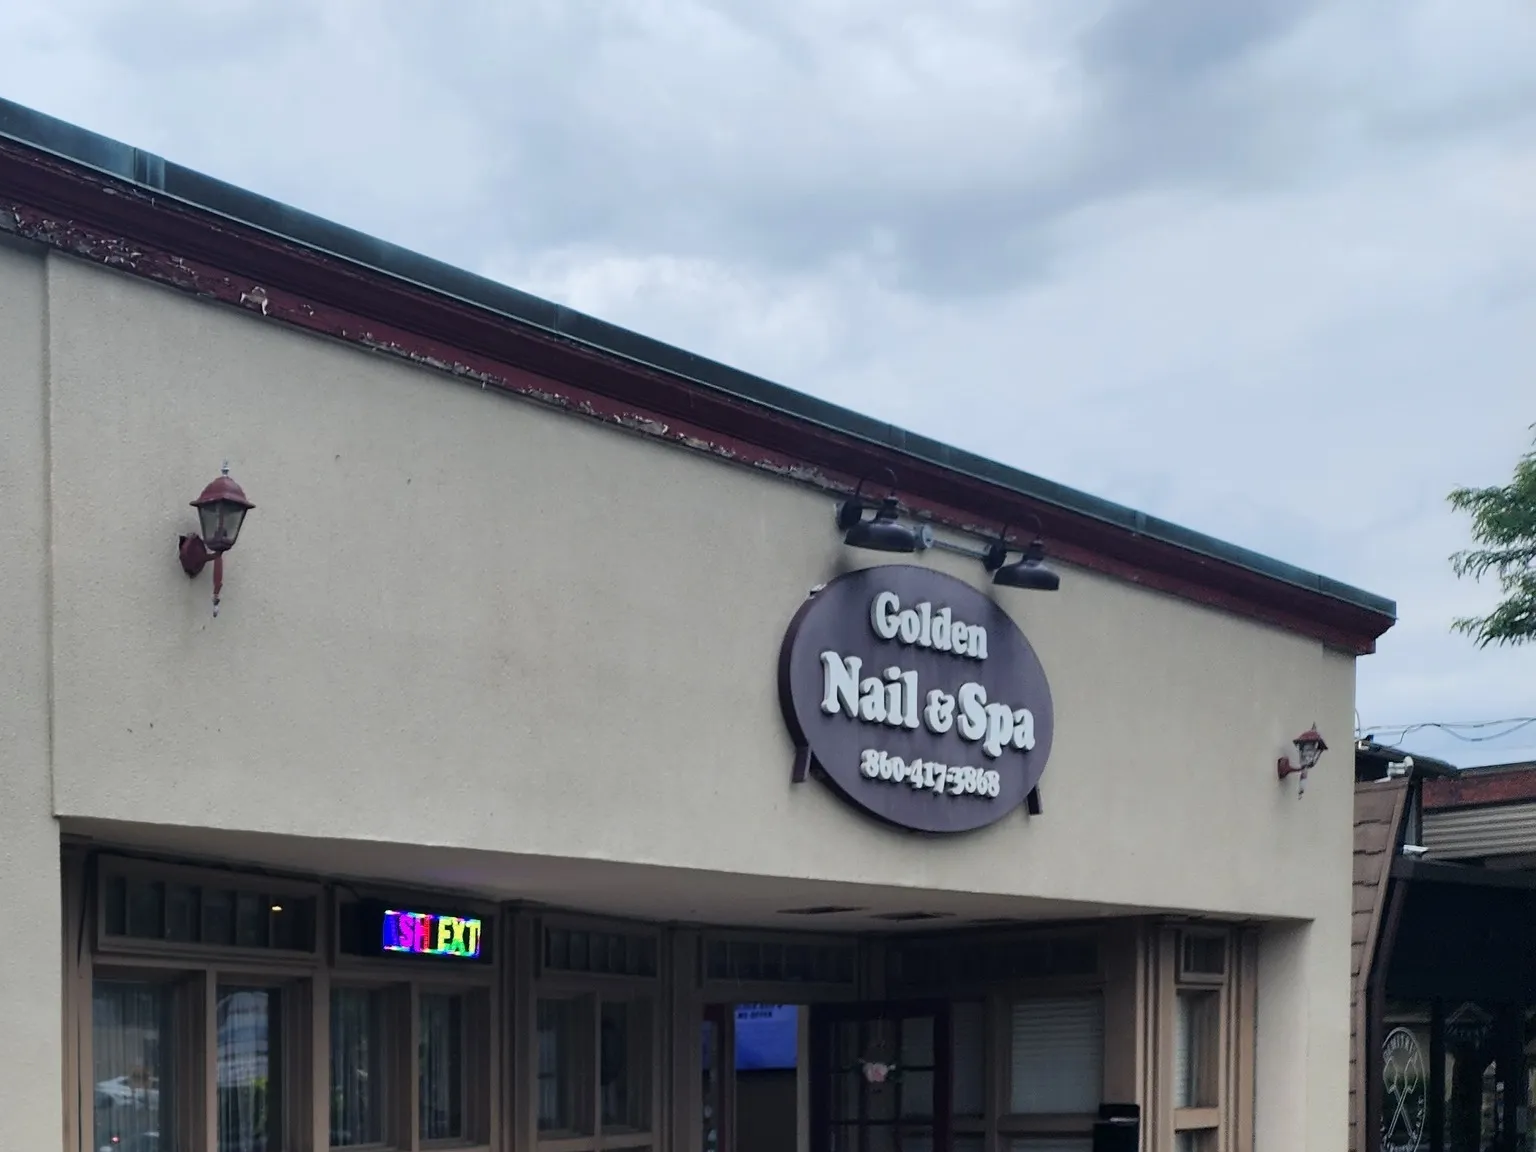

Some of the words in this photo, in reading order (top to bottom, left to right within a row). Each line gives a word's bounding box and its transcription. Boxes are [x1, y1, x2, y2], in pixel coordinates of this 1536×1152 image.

[871, 591, 988, 659] Golden
[820, 651, 919, 728] Nail
[924, 689, 955, 733] &
[958, 682, 1035, 757] Spa
[861, 749, 1000, 797] 860-417-3868
